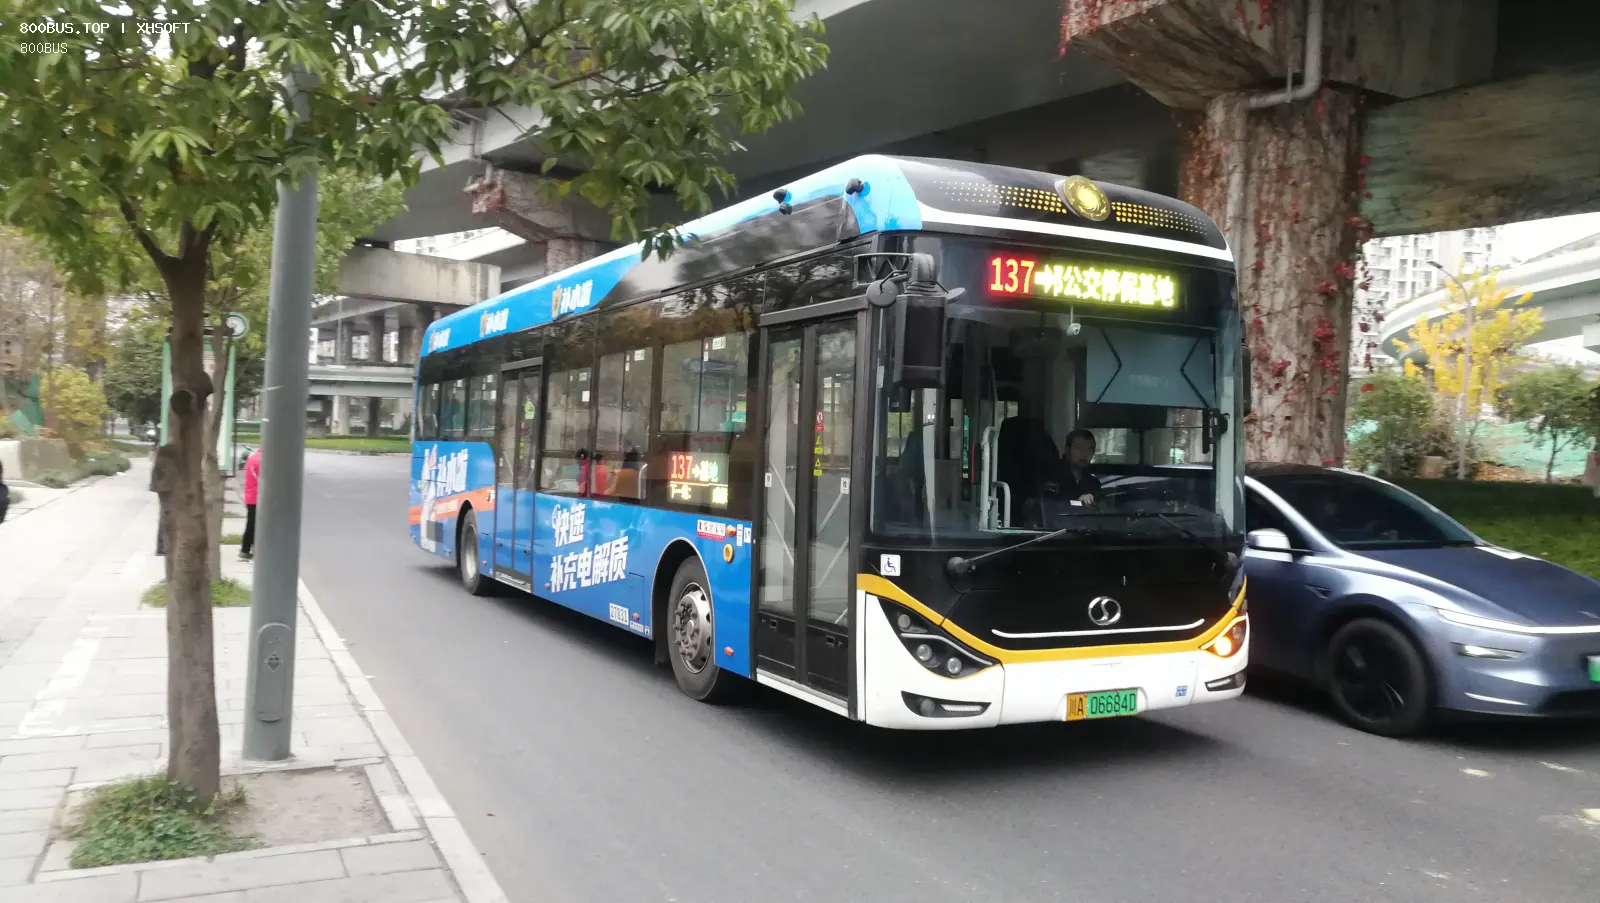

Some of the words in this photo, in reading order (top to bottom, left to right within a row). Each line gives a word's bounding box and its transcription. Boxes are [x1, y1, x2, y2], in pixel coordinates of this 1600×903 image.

[990, 257, 1035, 294] 137
[671, 455, 693, 480] 137
[553, 503, 586, 547] 快速
[550, 536, 629, 593] 补充电解质
